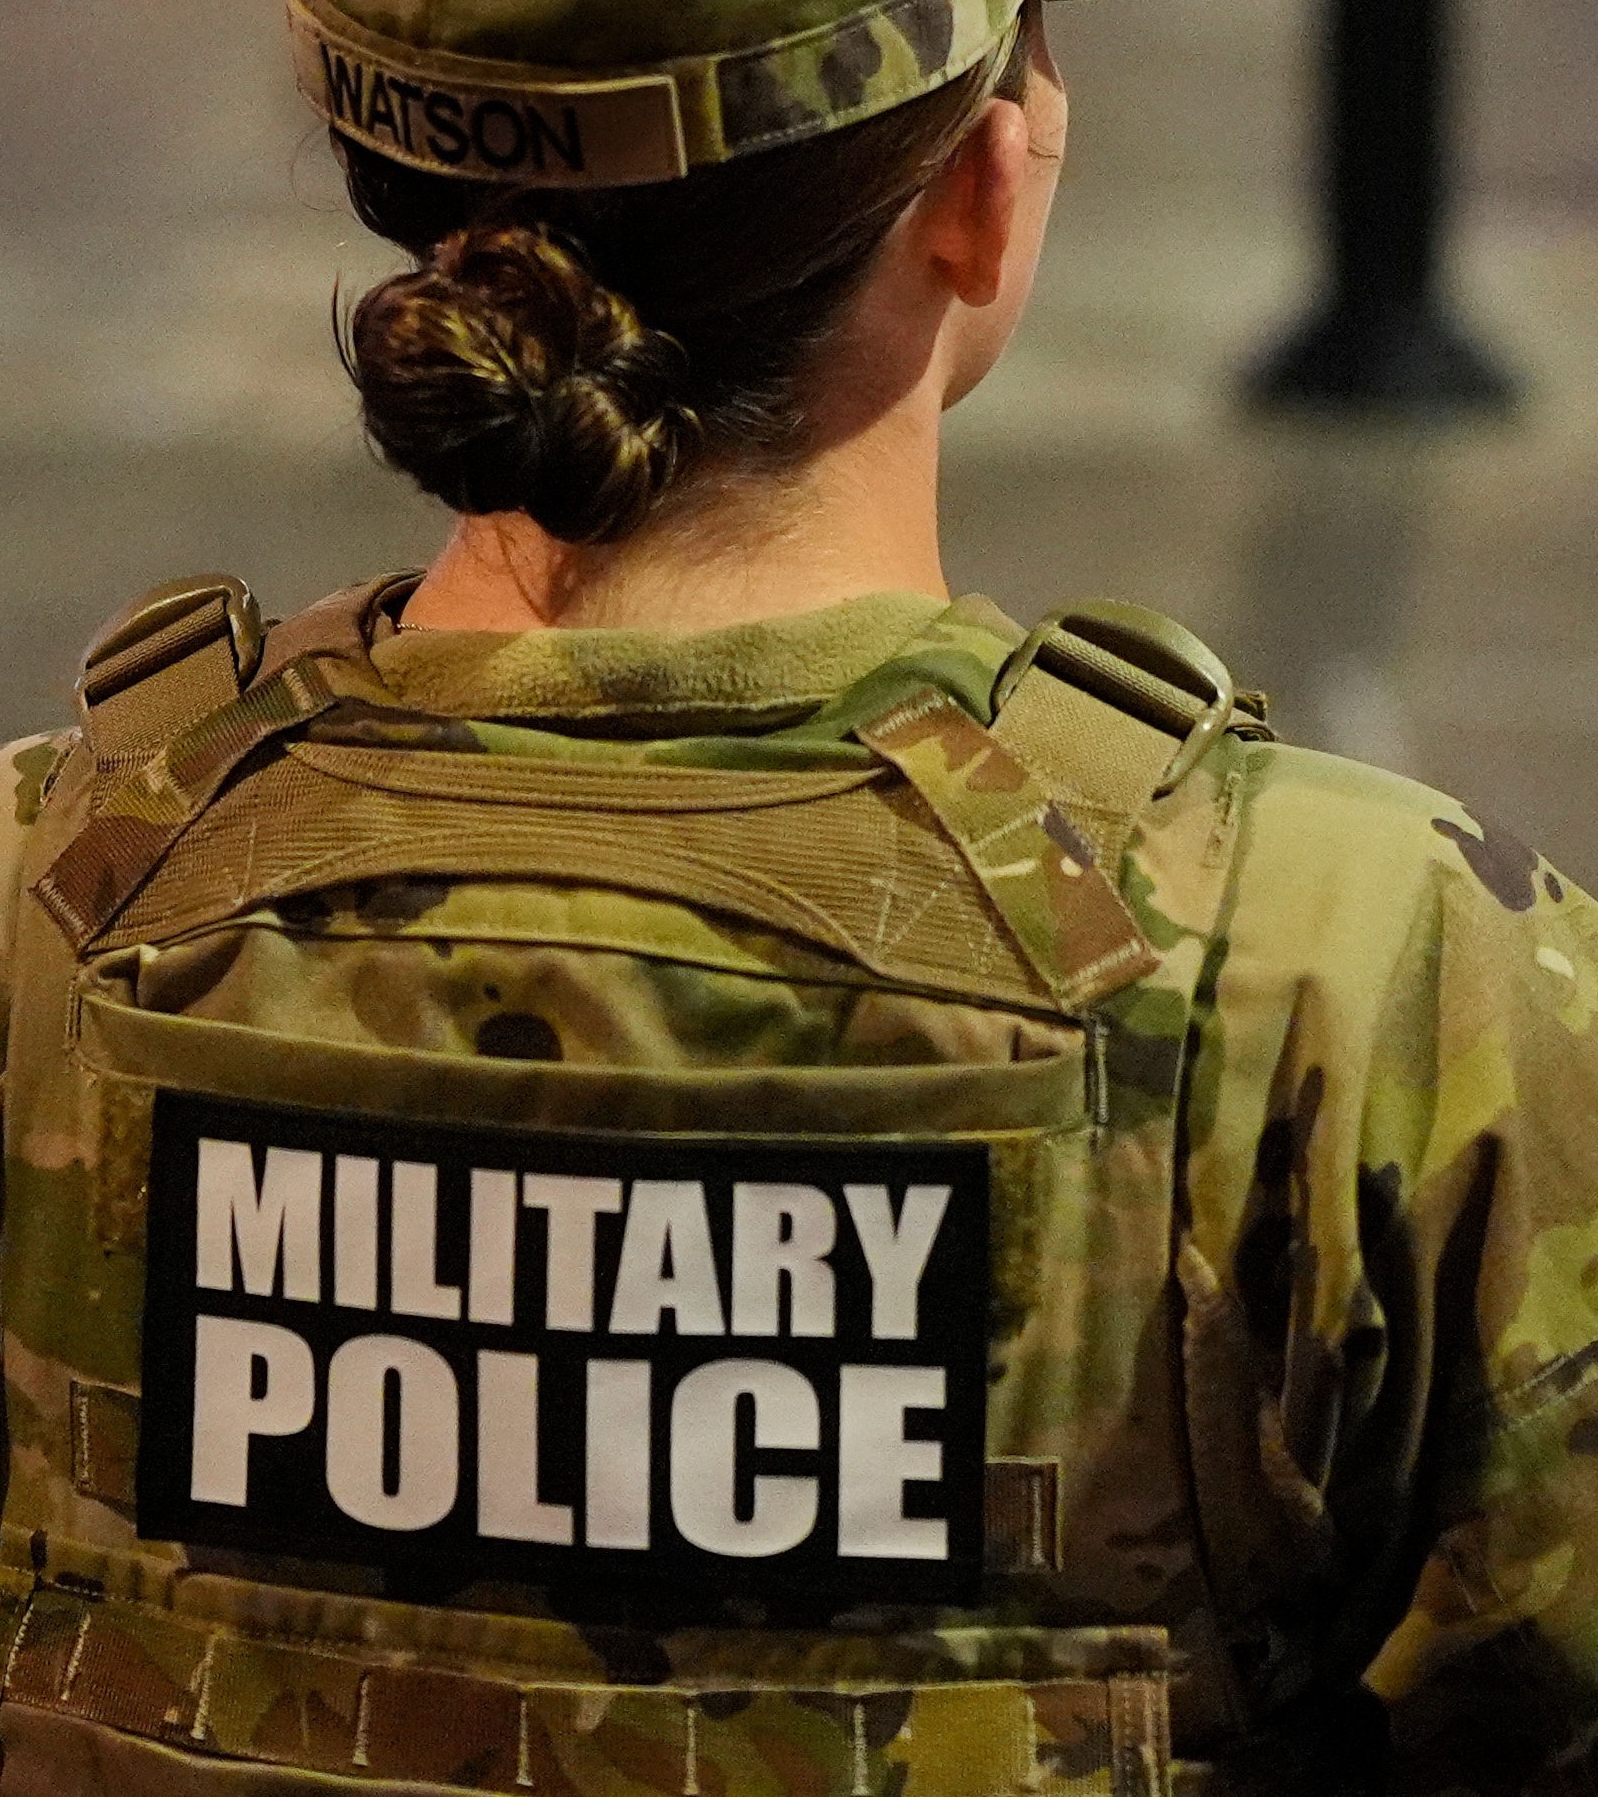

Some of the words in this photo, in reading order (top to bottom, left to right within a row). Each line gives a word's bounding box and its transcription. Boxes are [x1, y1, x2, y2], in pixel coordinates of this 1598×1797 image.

[321, 42, 585, 171] WATSON
[196, 1137, 951, 1340] MILITARY
[190, 1314, 949, 1561] POLICE
